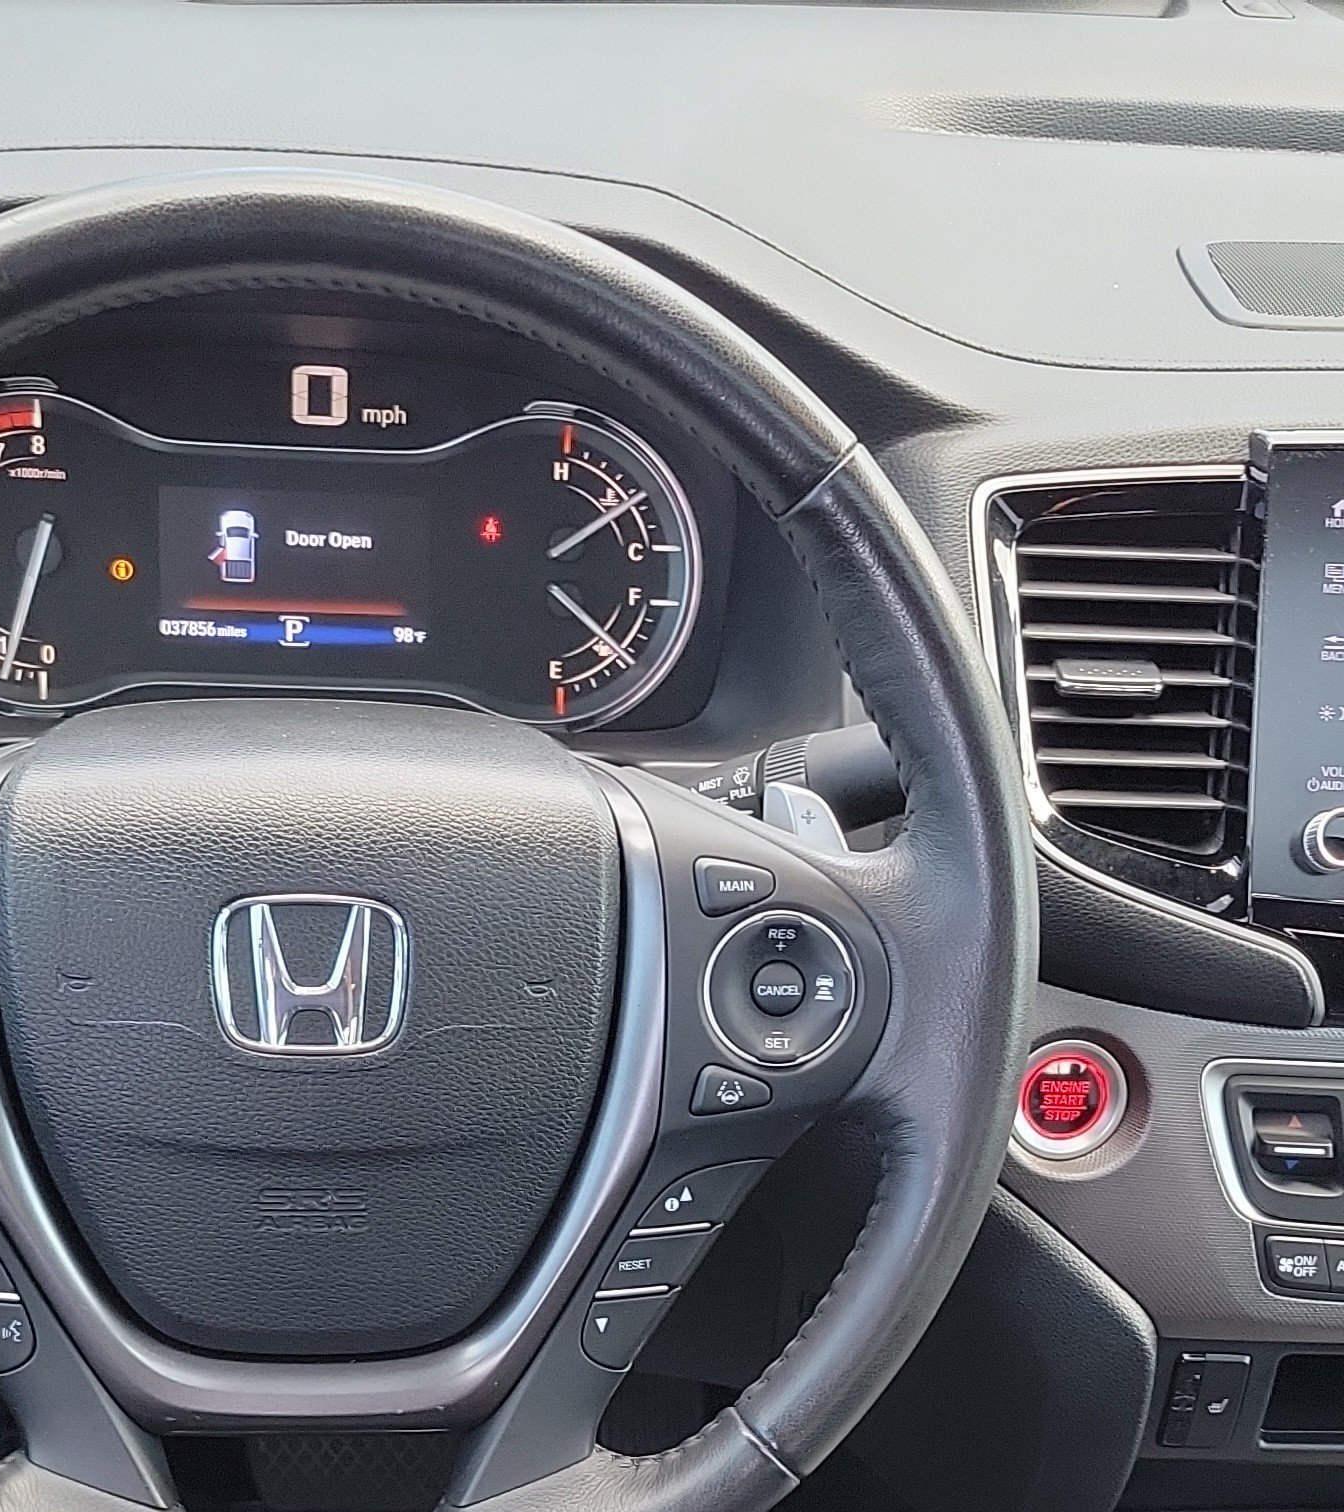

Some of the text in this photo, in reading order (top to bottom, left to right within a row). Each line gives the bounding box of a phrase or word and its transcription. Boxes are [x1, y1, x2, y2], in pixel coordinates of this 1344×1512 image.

[362, 405, 407, 428] mph
[31, 435, 45, 454] 8
[555, 462, 570, 481] H
[285, 530, 372, 551] Door Open
[627, 542, 644, 562] C
[628, 588, 642, 606] F
[159, 619, 247, 638] 037856 miles
[285, 619, 303, 642] P
[41, 645, 55, 664] 0
[549, 660, 563, 679] E
[698, 776, 724, 792] MIST
[729, 786, 756, 800] PULL
[718, 878, 755, 894] MAIN
[767, 926, 797, 942] RES
[756, 983, 803, 998] CANCEL
[763, 1035, 792, 1051] SET
[1040, 1080, 1091, 1094] ENGINE
[1043, 1094, 1086, 1106] START
[1044, 1110, 1081, 1121] STOP
[618, 1258, 653, 1272] RESET
[1294, 1255, 1318, 1267] ON/
[1293, 1266, 1317, 1278] OFF
